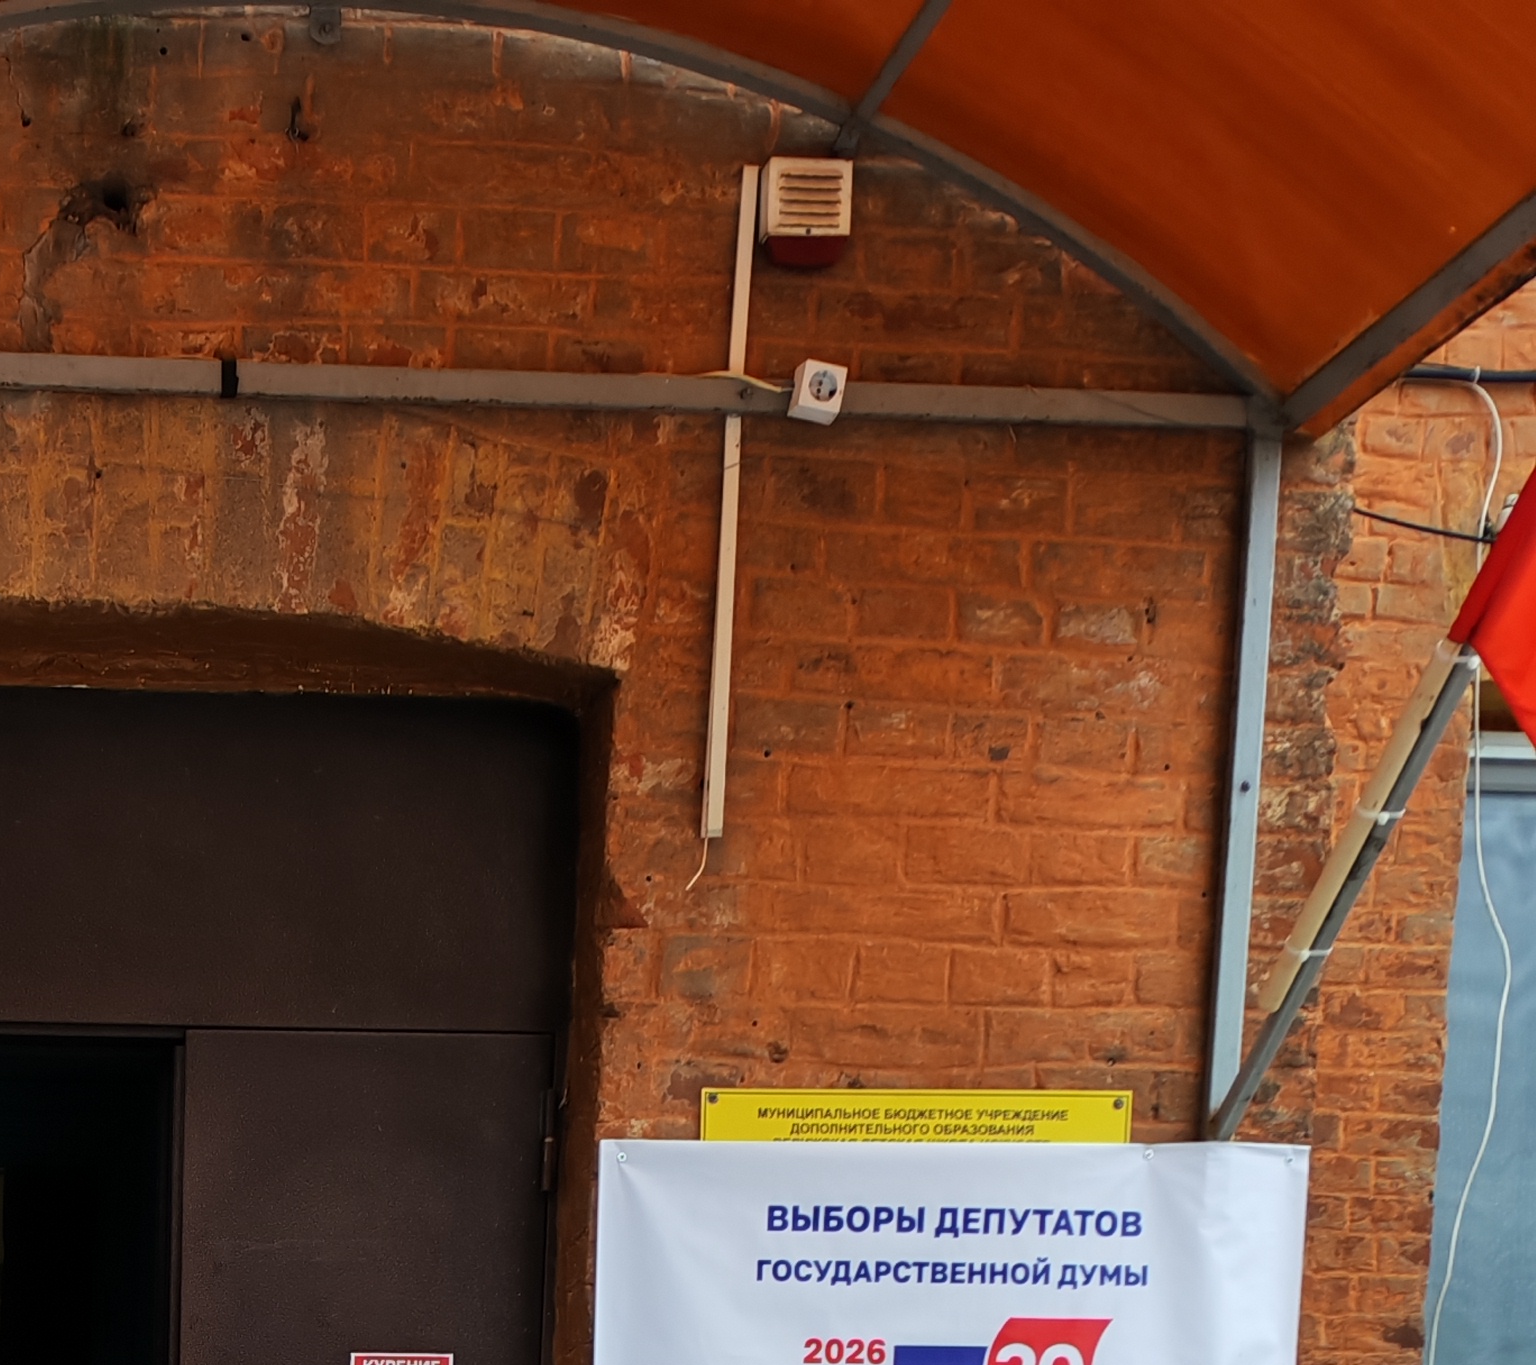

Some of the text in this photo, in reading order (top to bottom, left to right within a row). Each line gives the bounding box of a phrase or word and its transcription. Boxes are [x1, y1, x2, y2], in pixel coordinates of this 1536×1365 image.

[758, 1107, 1068, 1122] МУНИЦИПАЛЬНОЕ БЮДЖЕТНОЕ УЧРЕЖДЕНИЕ
[790, 1122, 1035, 1137] ДОПОЛНИТЕЛЬНОГО ОБРАЗОВАНИЯ
[767, 1205, 1143, 1238] ВЫБОРЫ ДЕПУТАТОВ
[756, 1257, 1149, 1290] ГОСУДАРСТВЕННОЙ ДУМЫ
[803, 1338, 886, 1365] 2026
